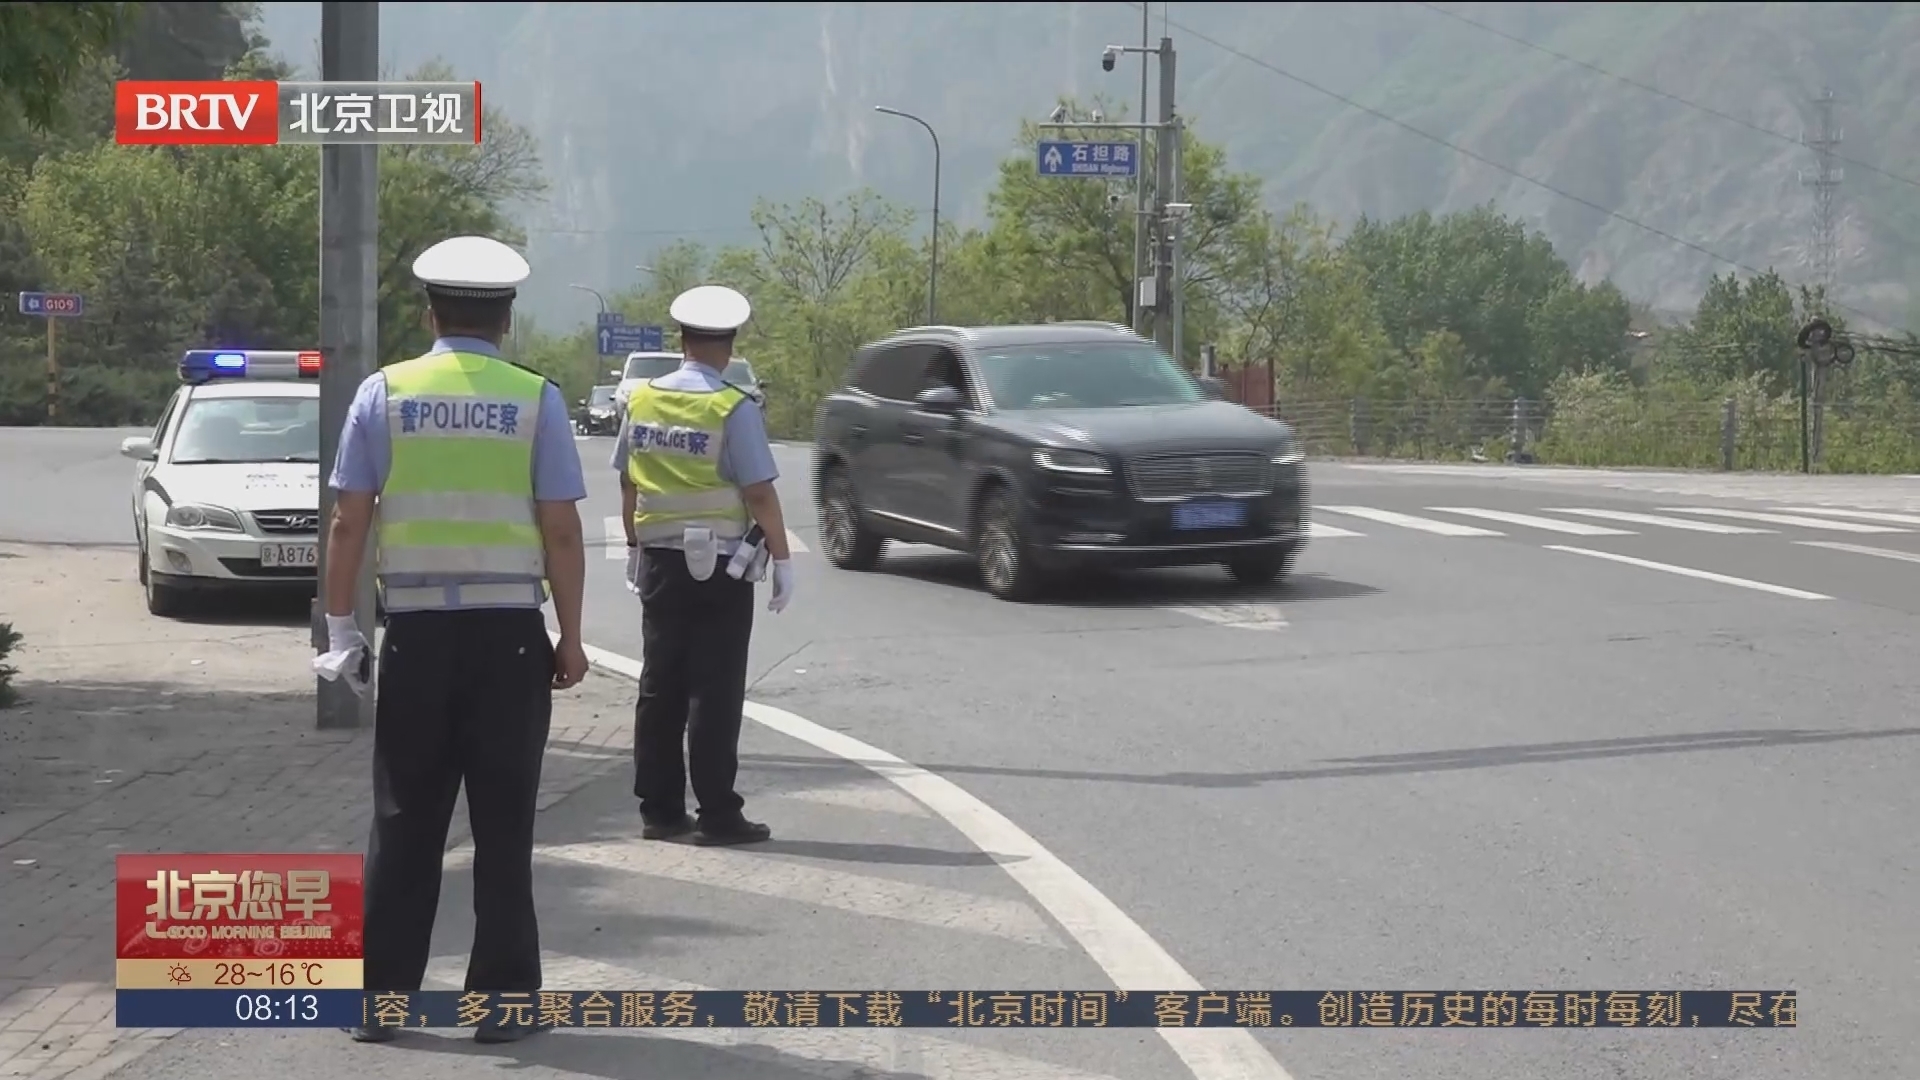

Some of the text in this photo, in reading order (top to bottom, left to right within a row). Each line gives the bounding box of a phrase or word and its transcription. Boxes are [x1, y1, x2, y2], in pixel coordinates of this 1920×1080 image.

[1071, 144, 1130, 162] 石担路
[46, 299, 74, 310] G109
